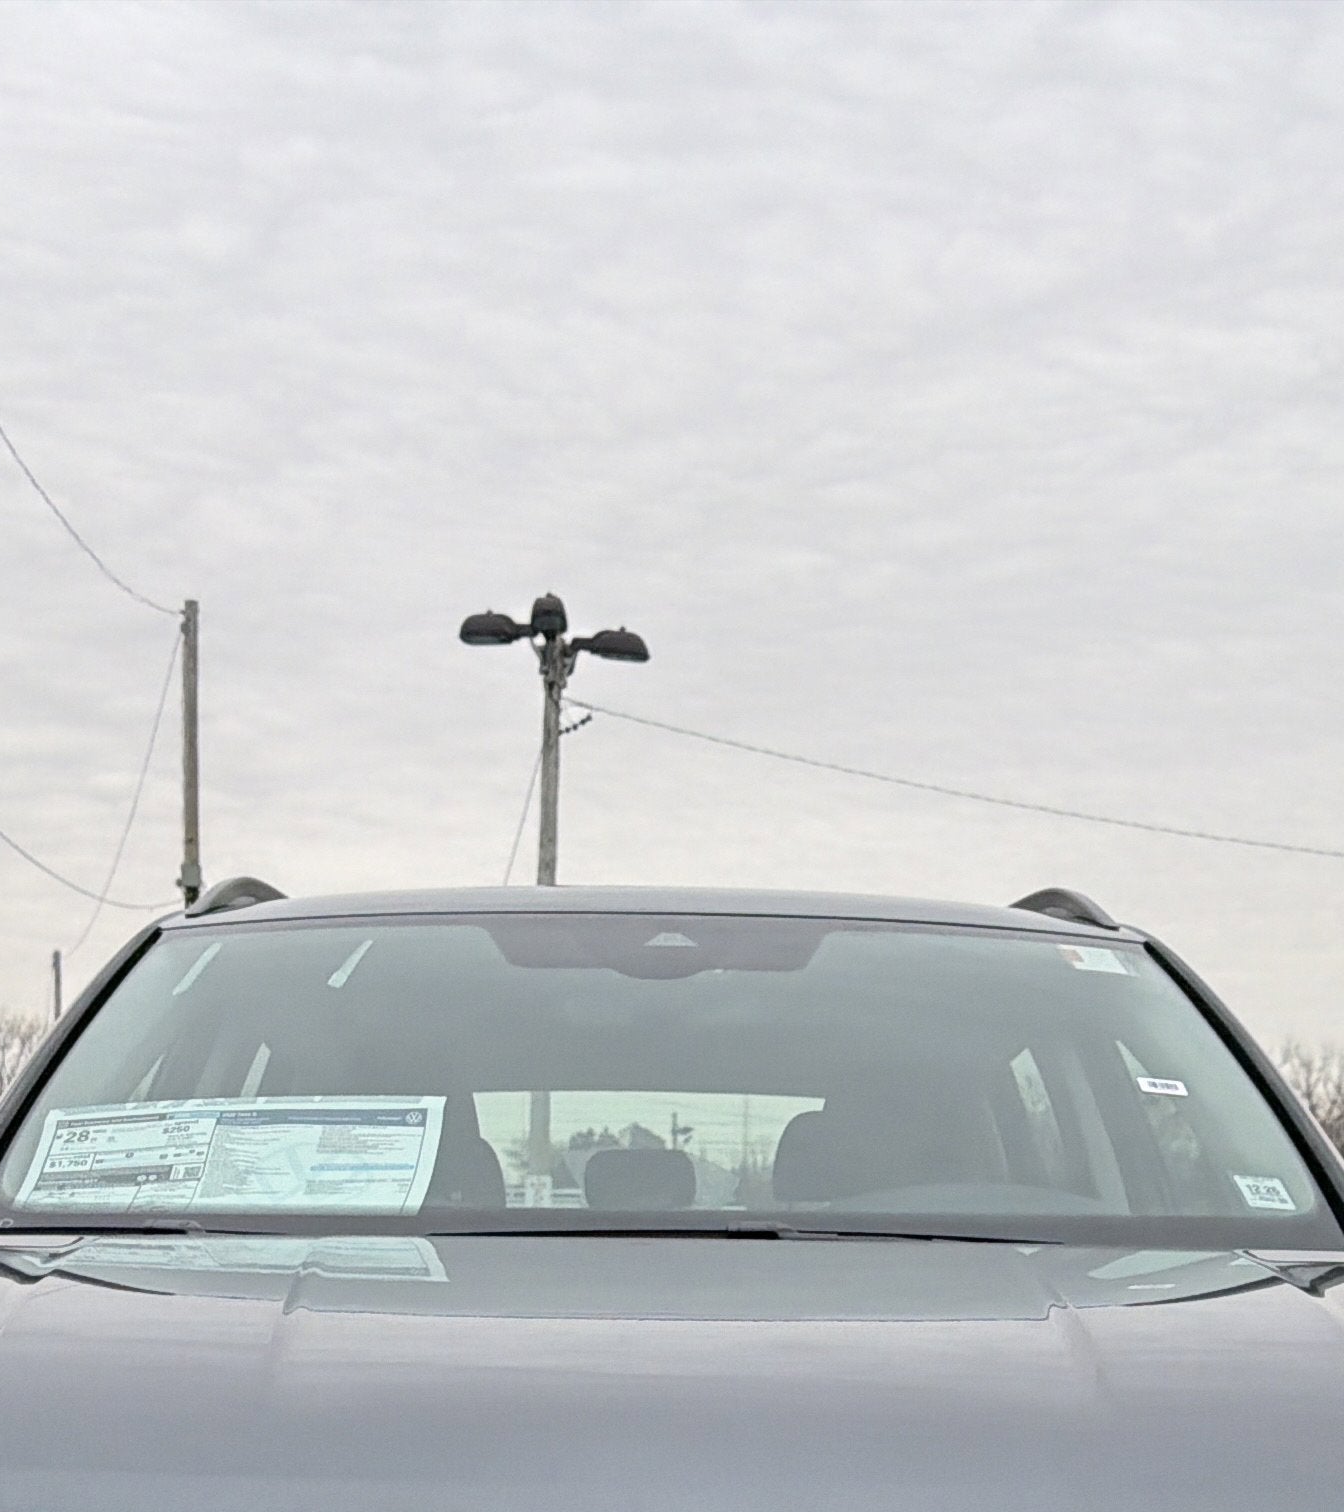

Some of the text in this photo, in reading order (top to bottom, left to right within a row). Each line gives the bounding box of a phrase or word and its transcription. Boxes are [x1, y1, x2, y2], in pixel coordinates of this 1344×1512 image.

[162, 1125, 190, 1135] $250
[63, 1130, 90, 1144] 28
[49, 1159, 88, 1169] $1,750
